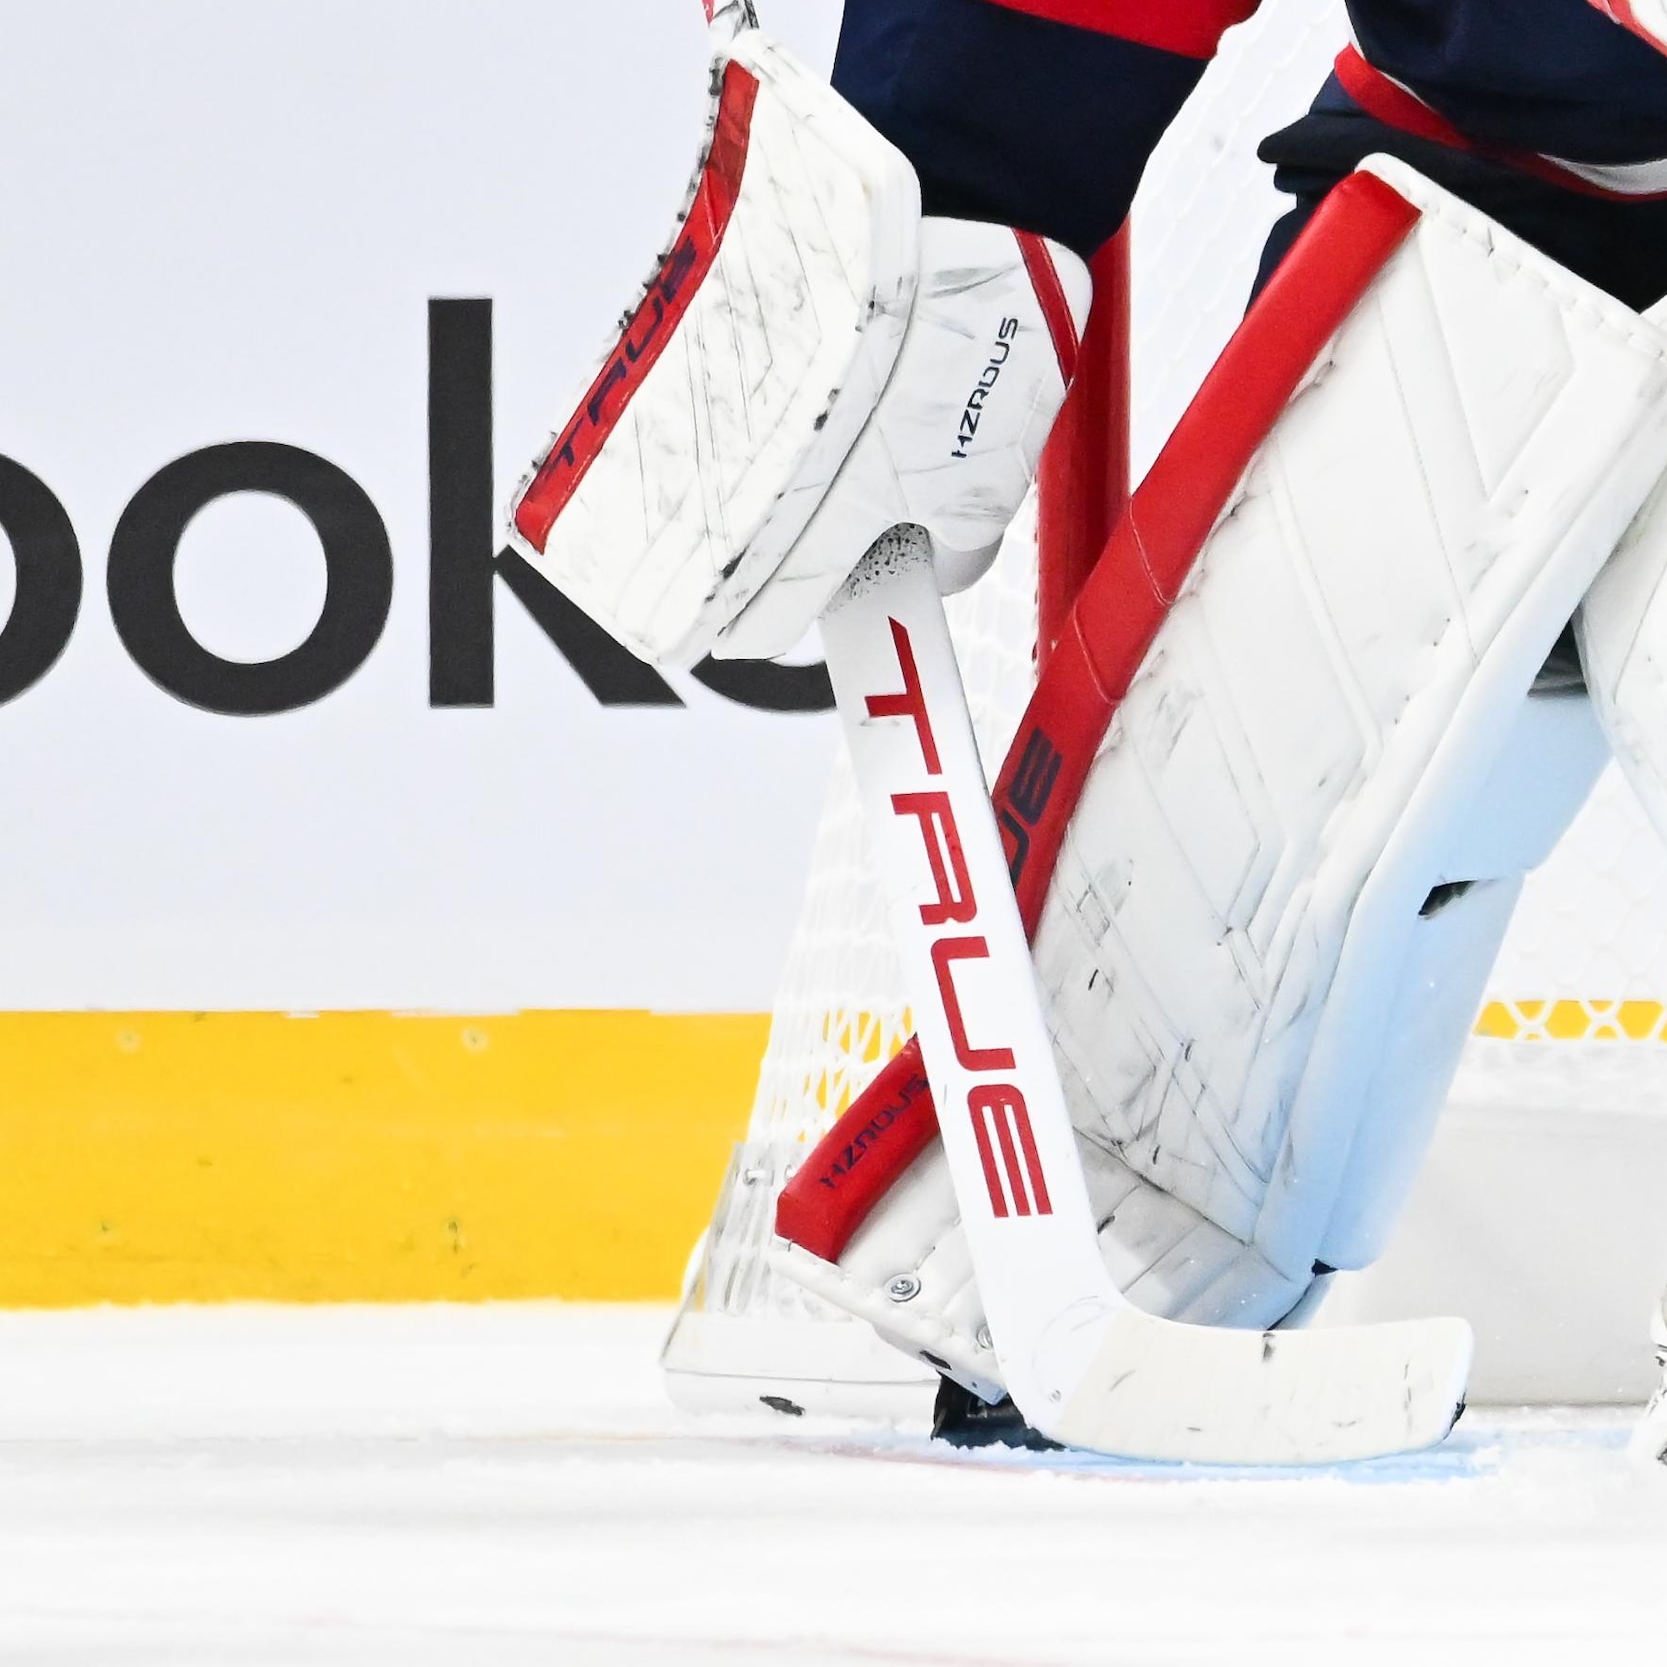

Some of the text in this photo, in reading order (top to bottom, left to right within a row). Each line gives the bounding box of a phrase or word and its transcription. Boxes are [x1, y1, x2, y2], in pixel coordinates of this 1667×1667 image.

[541, 235, 698, 481] TRUE
[951, 317, 1019, 458] HZRDUS
[864, 616, 1053, 1219] TRUE
